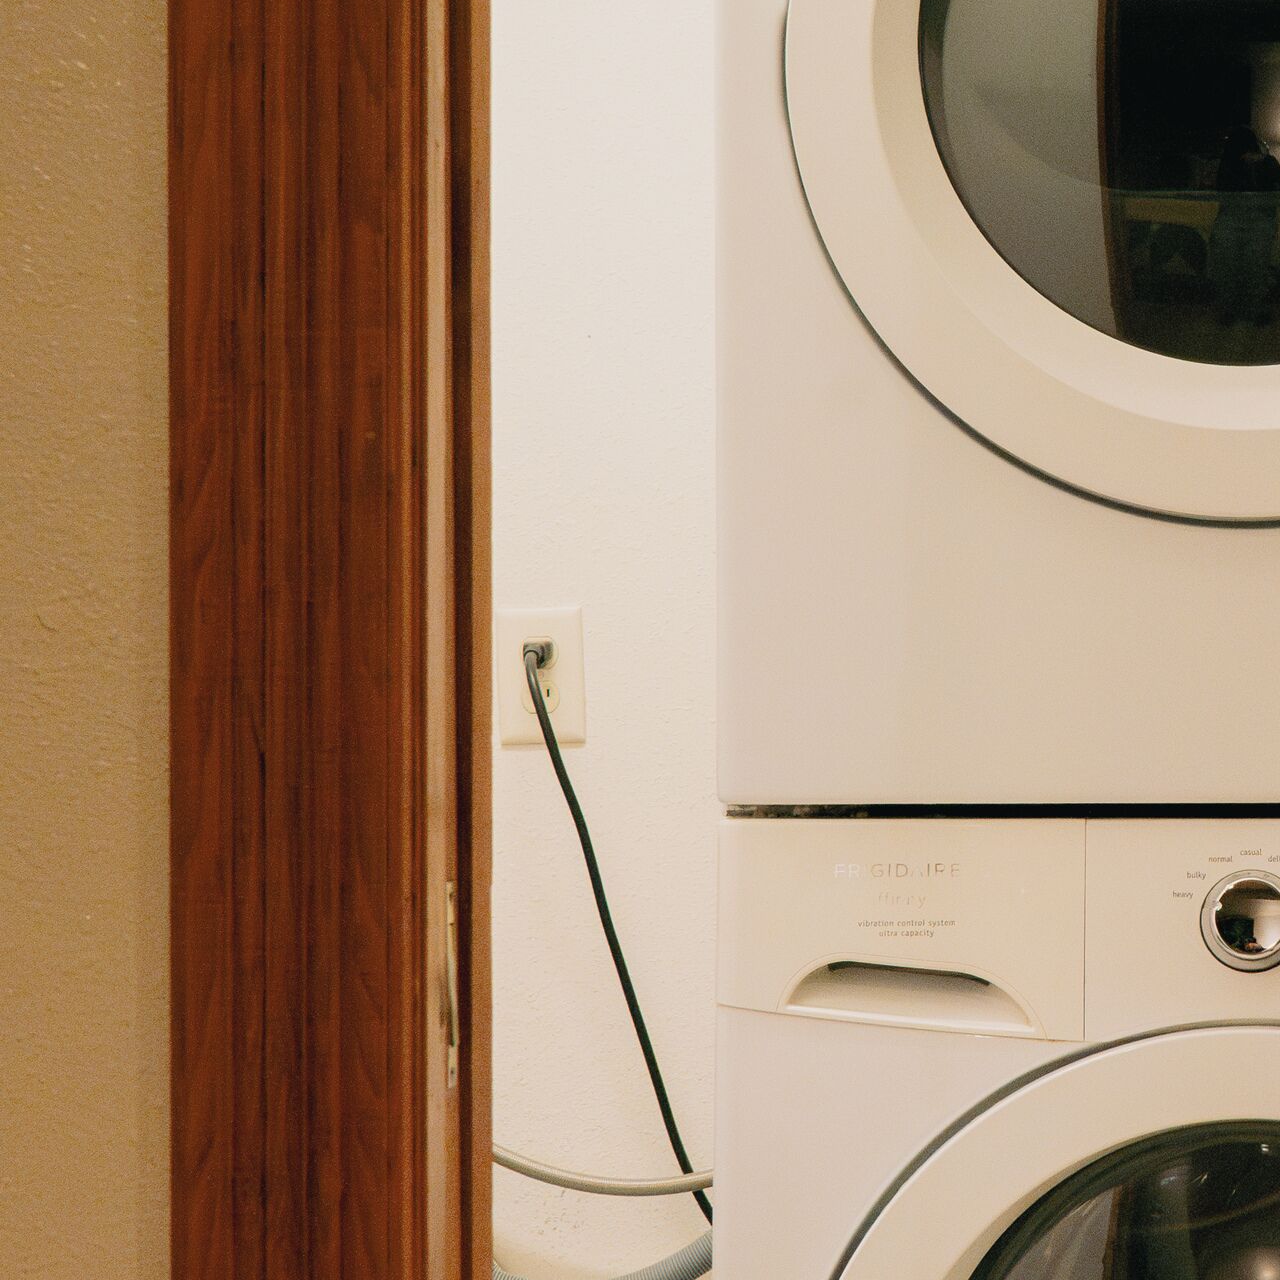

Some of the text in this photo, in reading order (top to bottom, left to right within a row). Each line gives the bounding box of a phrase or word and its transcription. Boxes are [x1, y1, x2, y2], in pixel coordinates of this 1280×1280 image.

[1240, 848, 1262, 856] casual
[1186, 871, 1207, 880] bulky
[1172, 890, 1194, 899] heavy
[858, 919, 956, 929] vibration control system
[878, 929, 935, 938] ultra capacity
